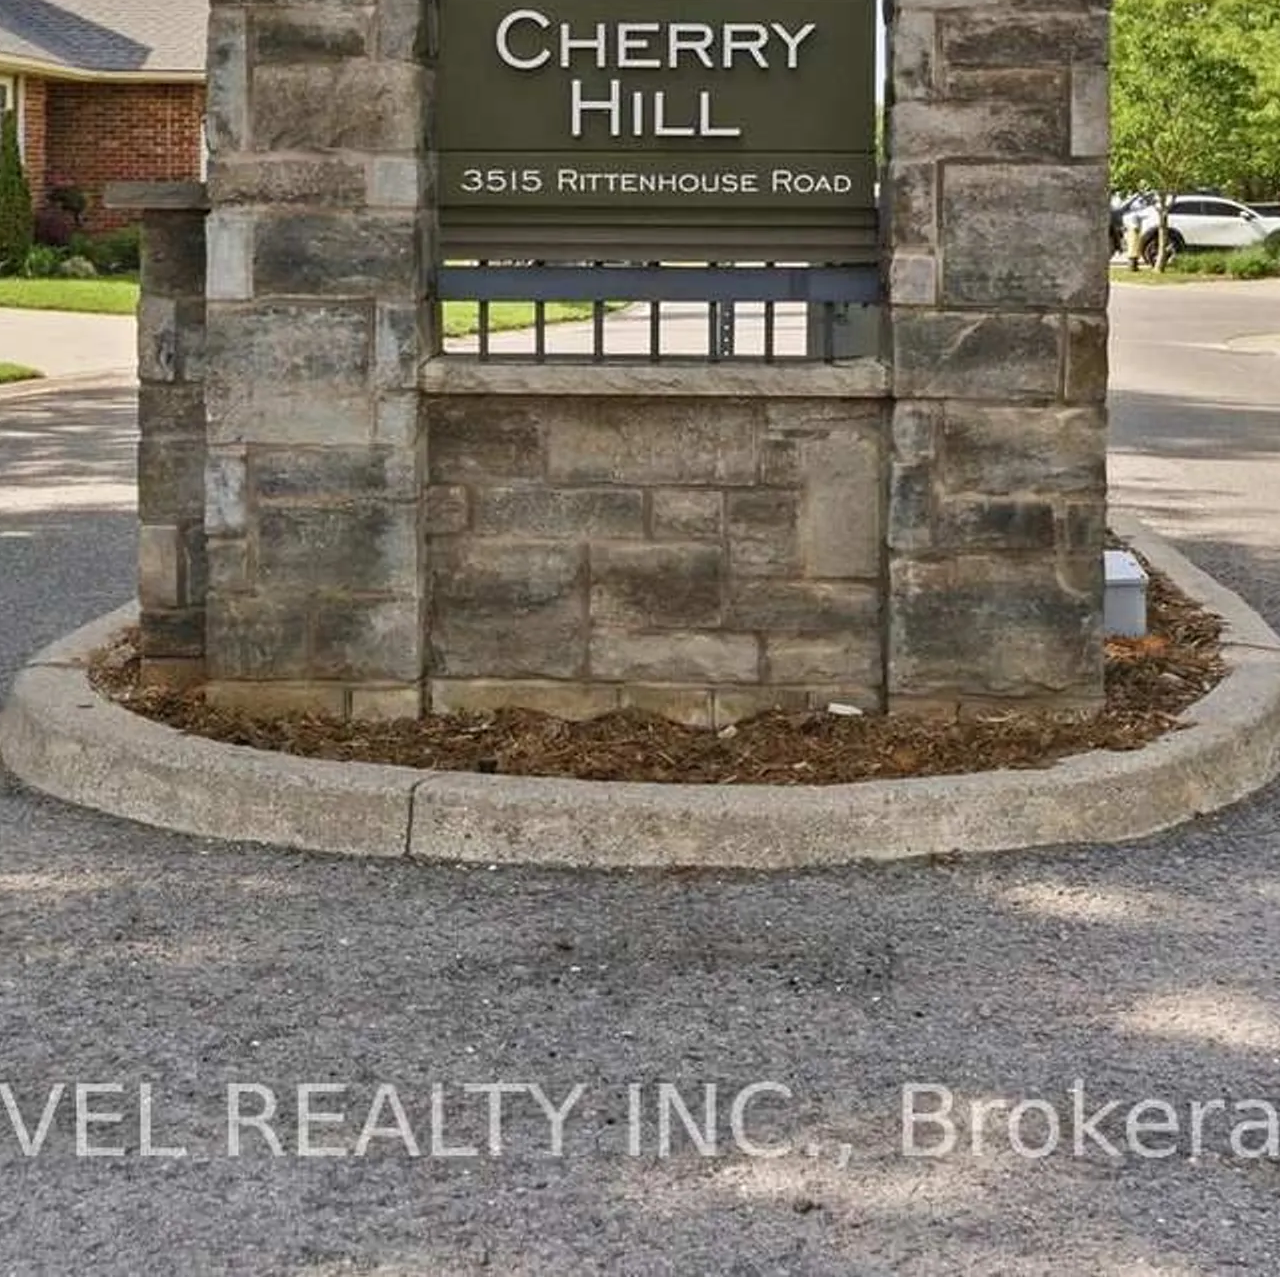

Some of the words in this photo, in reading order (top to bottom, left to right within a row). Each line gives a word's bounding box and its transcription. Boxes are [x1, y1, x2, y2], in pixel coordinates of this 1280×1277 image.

[495, 9, 818, 70] CHERRY
[570, 79, 742, 138] HILL
[460, 168, 543, 193] 3515
[556, 168, 760, 194] RITTENHOUSE
[770, 168, 853, 194] ROAD
